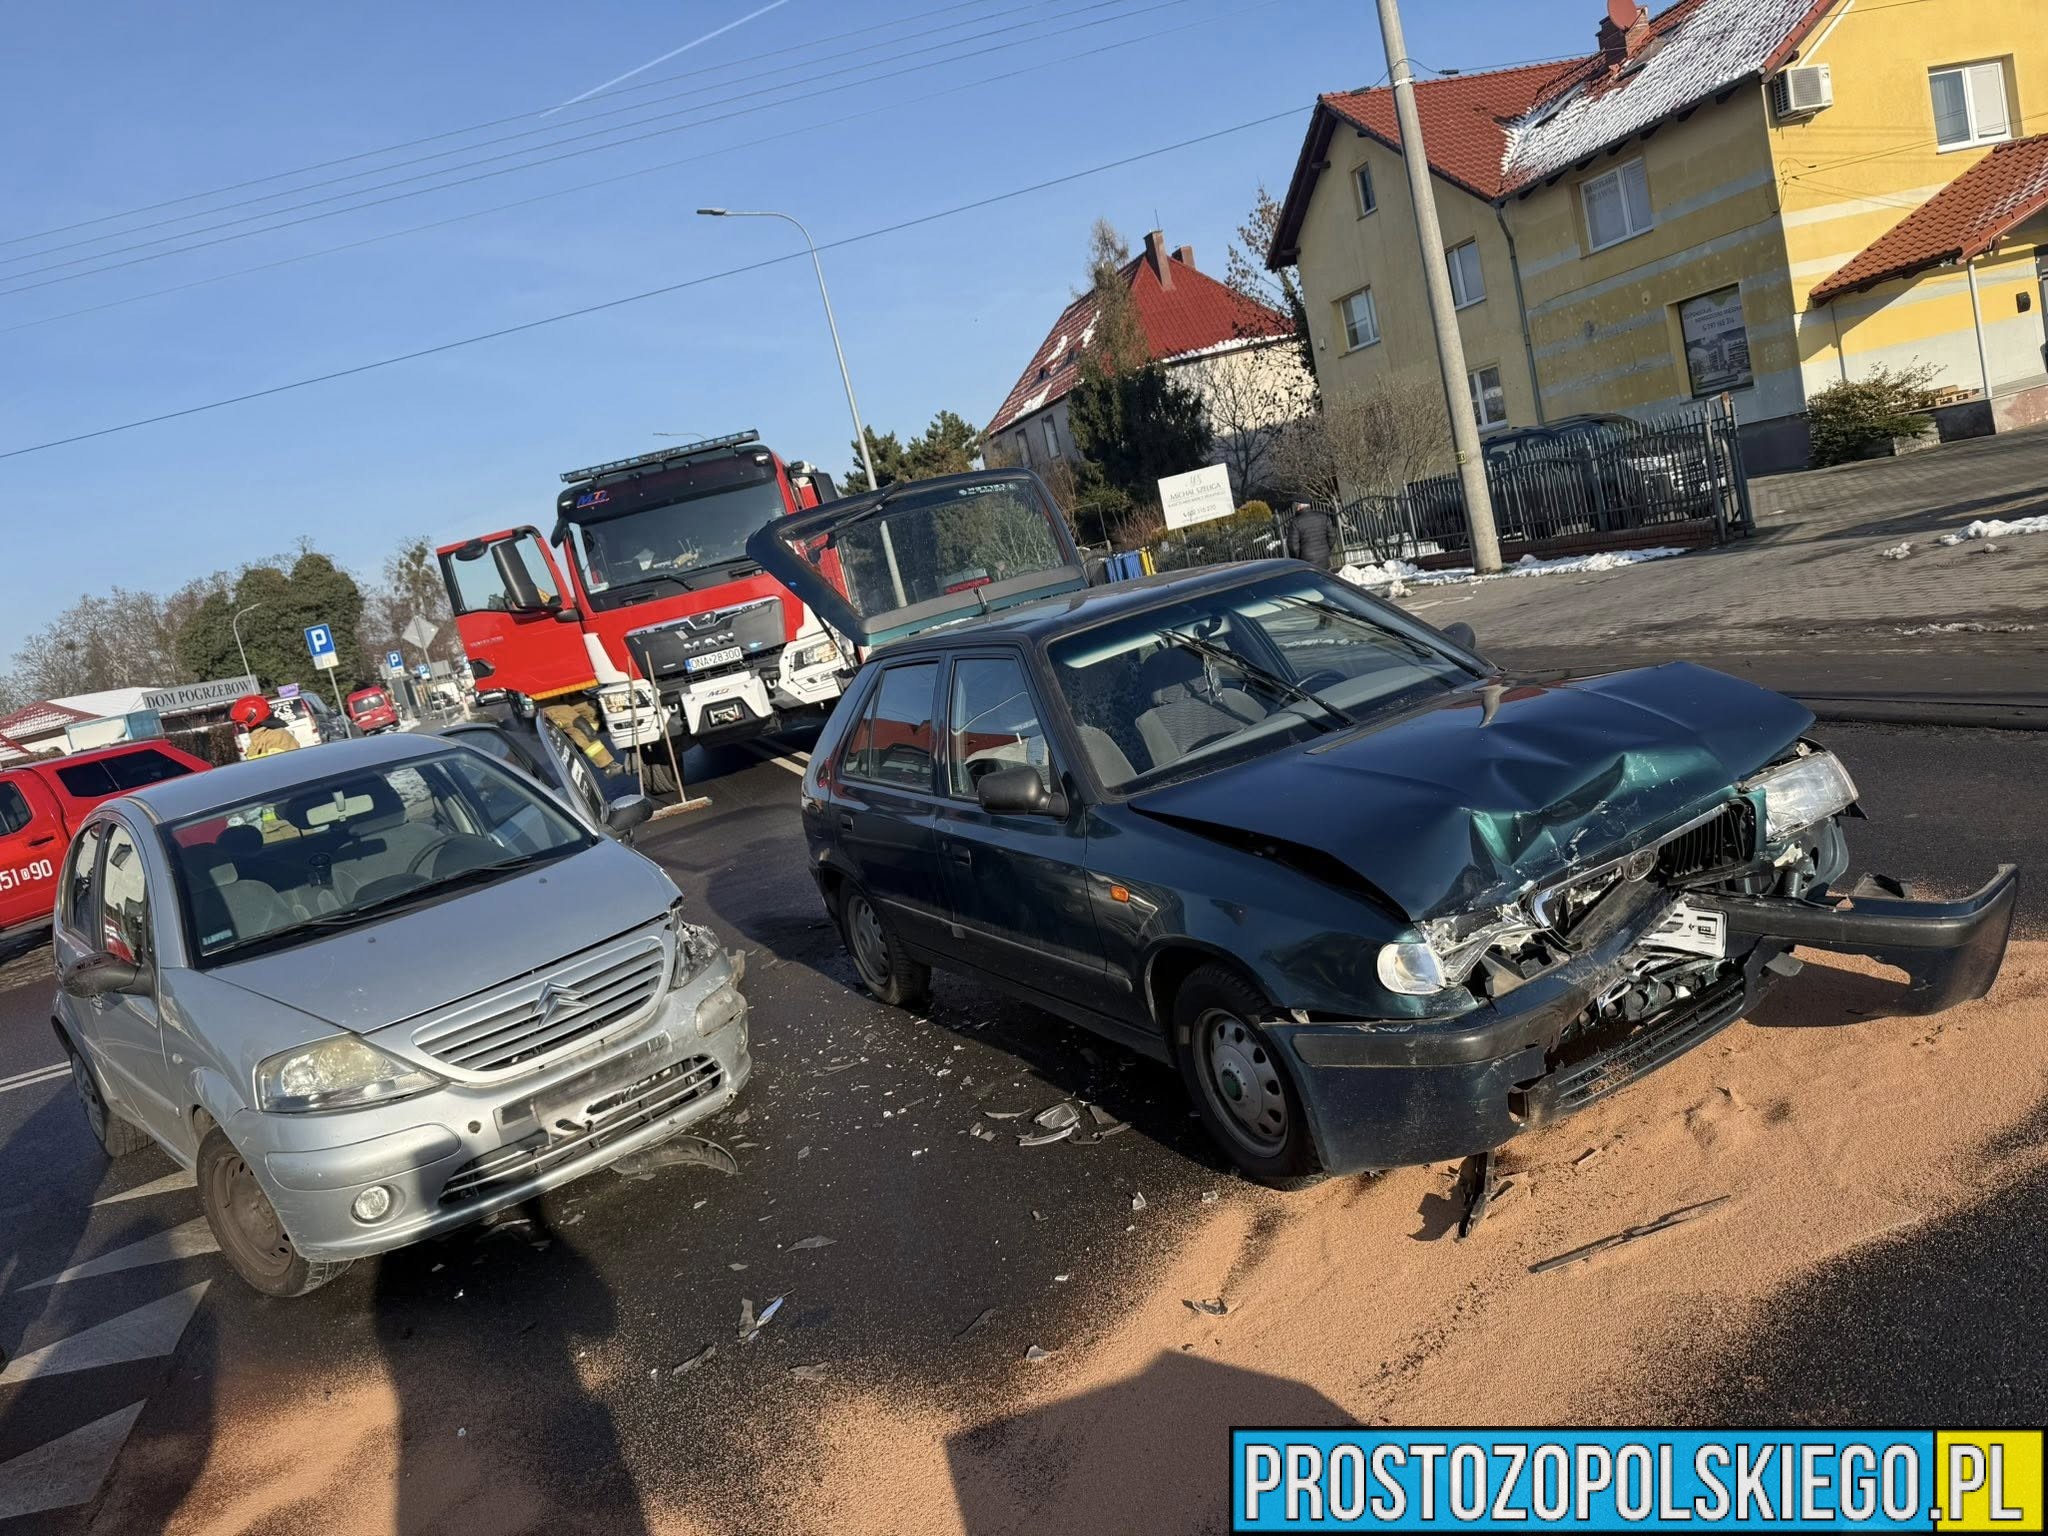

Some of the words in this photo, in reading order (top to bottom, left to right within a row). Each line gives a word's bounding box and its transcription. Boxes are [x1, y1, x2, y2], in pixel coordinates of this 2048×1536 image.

[310, 628, 327, 652] P
[683, 631, 734, 653] MAN
[390, 653, 399, 666] P
[146, 692, 177, 709] DOM
[179, 679, 254, 704] POGRZEBOW
